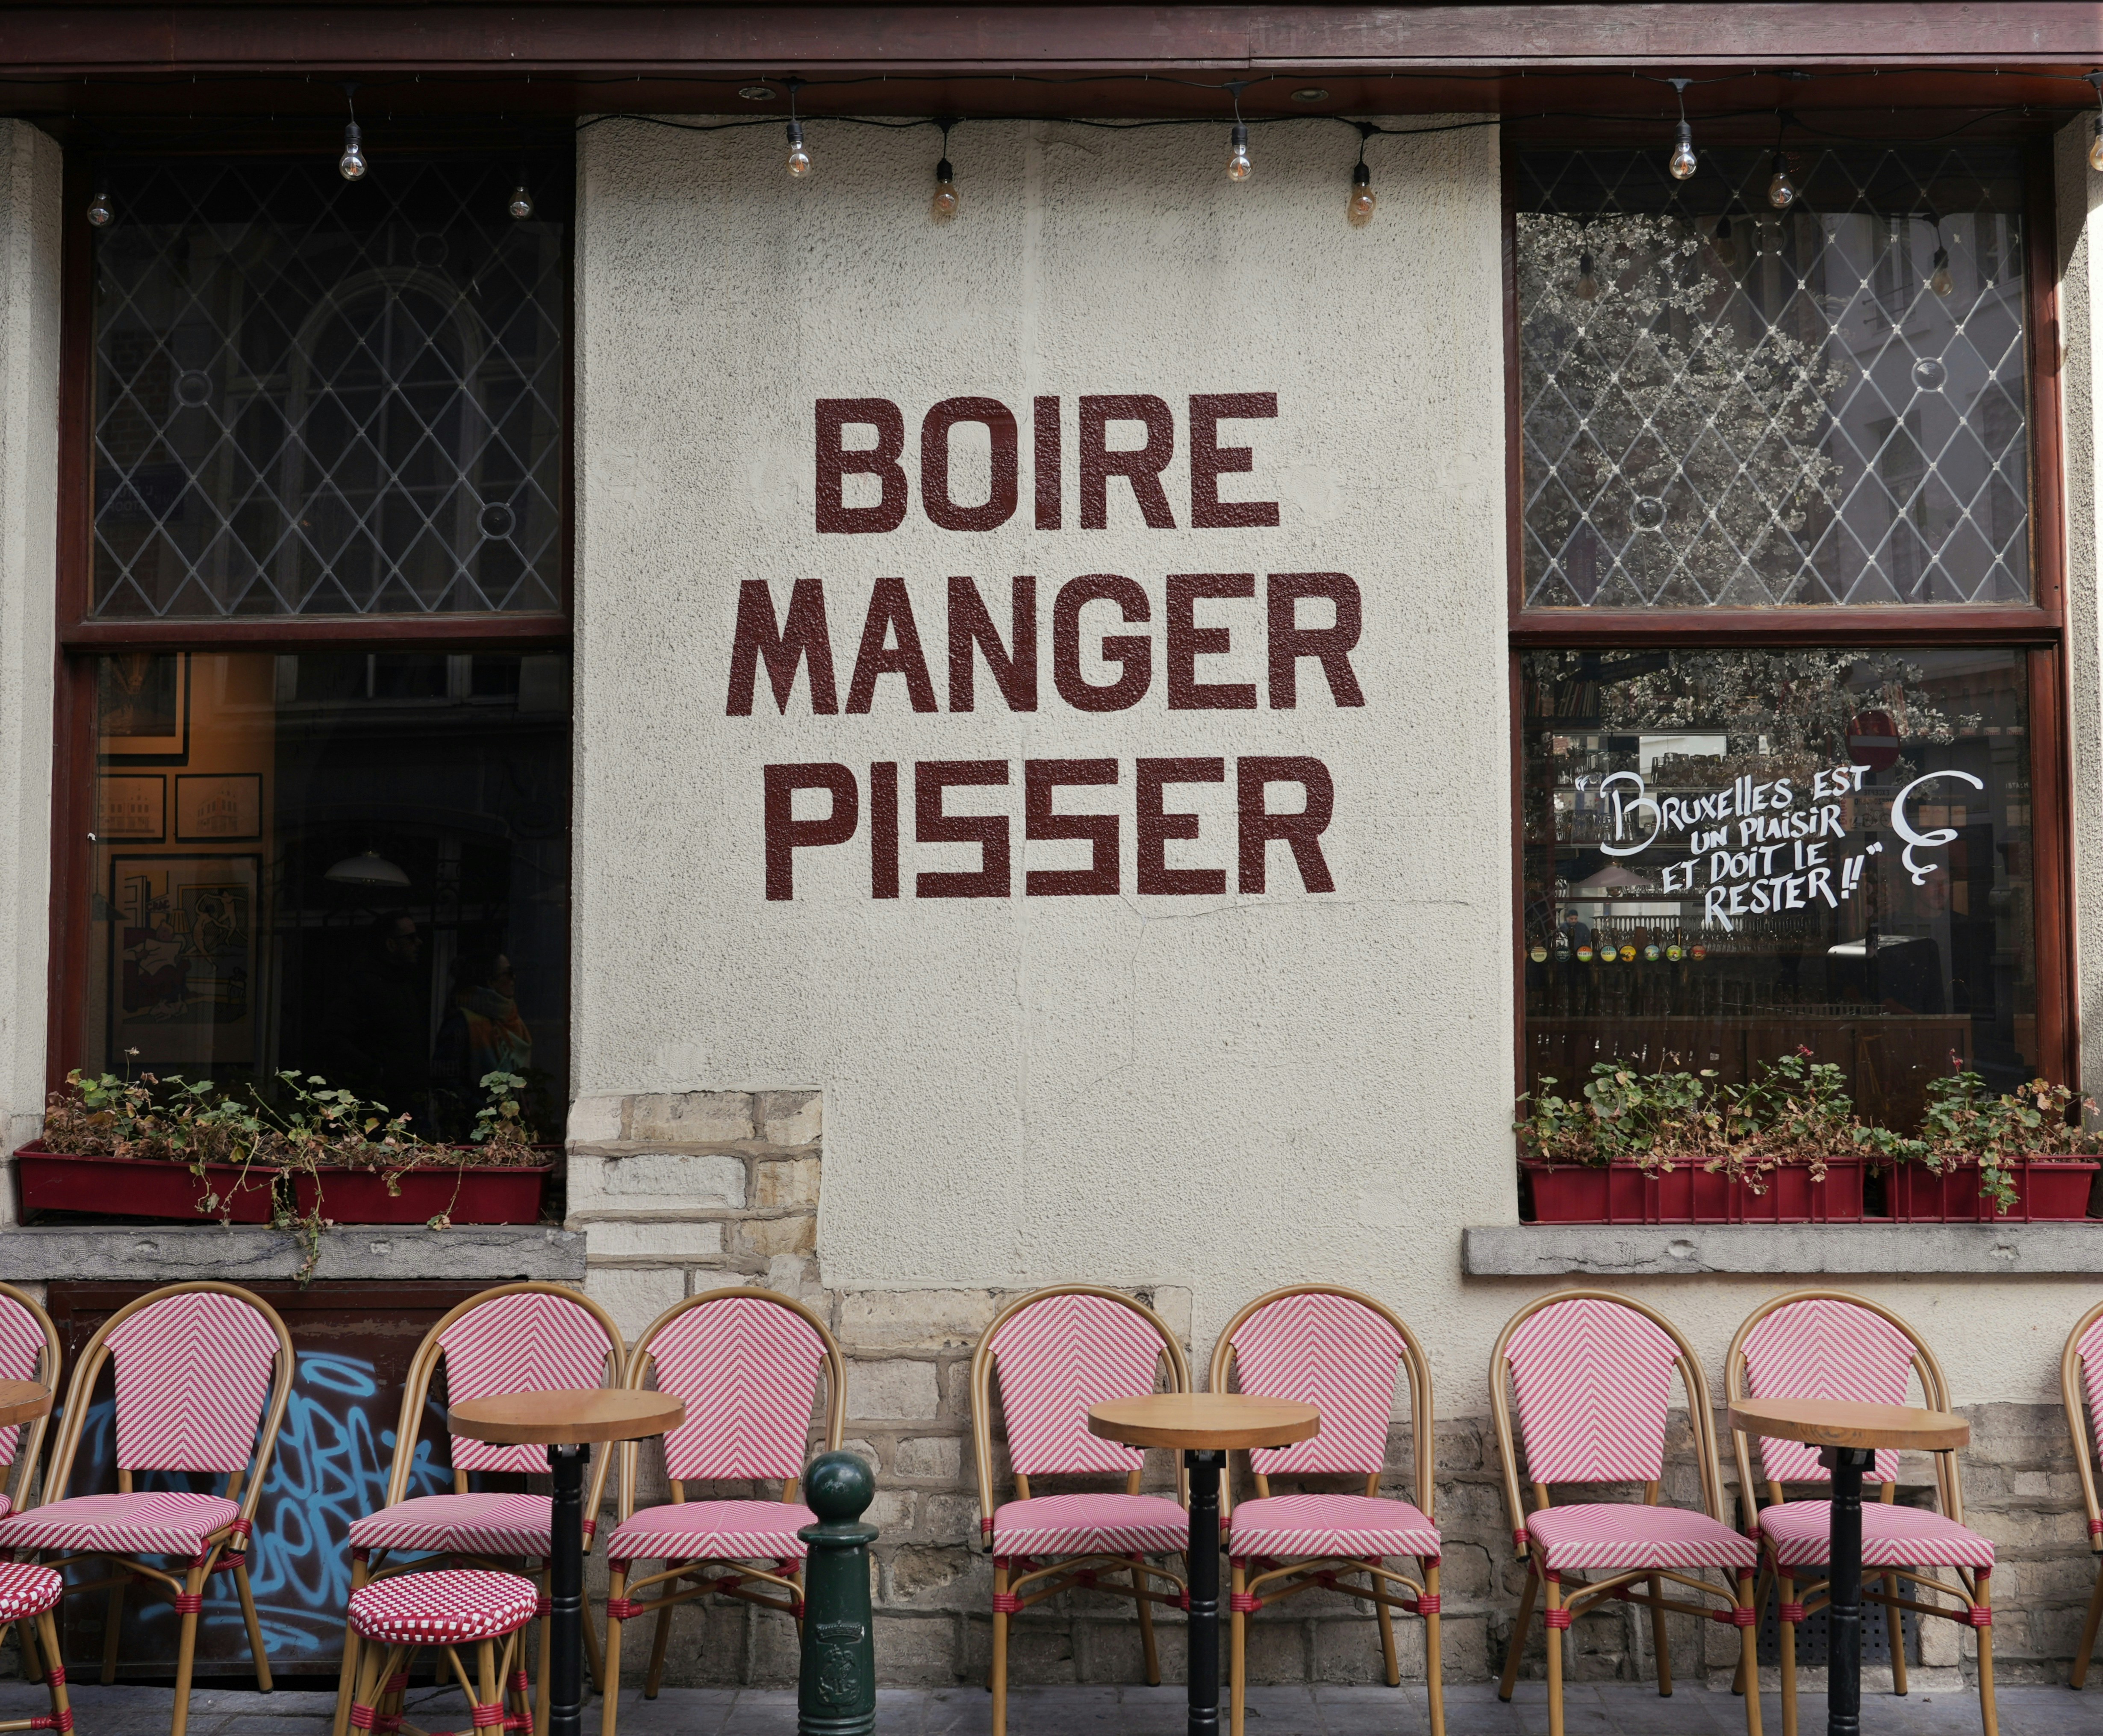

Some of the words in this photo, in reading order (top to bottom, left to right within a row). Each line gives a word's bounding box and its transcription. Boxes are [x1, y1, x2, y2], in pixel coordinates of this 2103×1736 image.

[815, 392, 1280, 534] BOIRE
[726, 572, 1365, 716] MANGER
[763, 756, 1335, 901] PISSER
[1813, 765, 1871, 801] EST
[1662, 858, 1700, 894] ET
[1794, 840, 1827, 870] LE
[1691, 825, 1728, 855] UN
